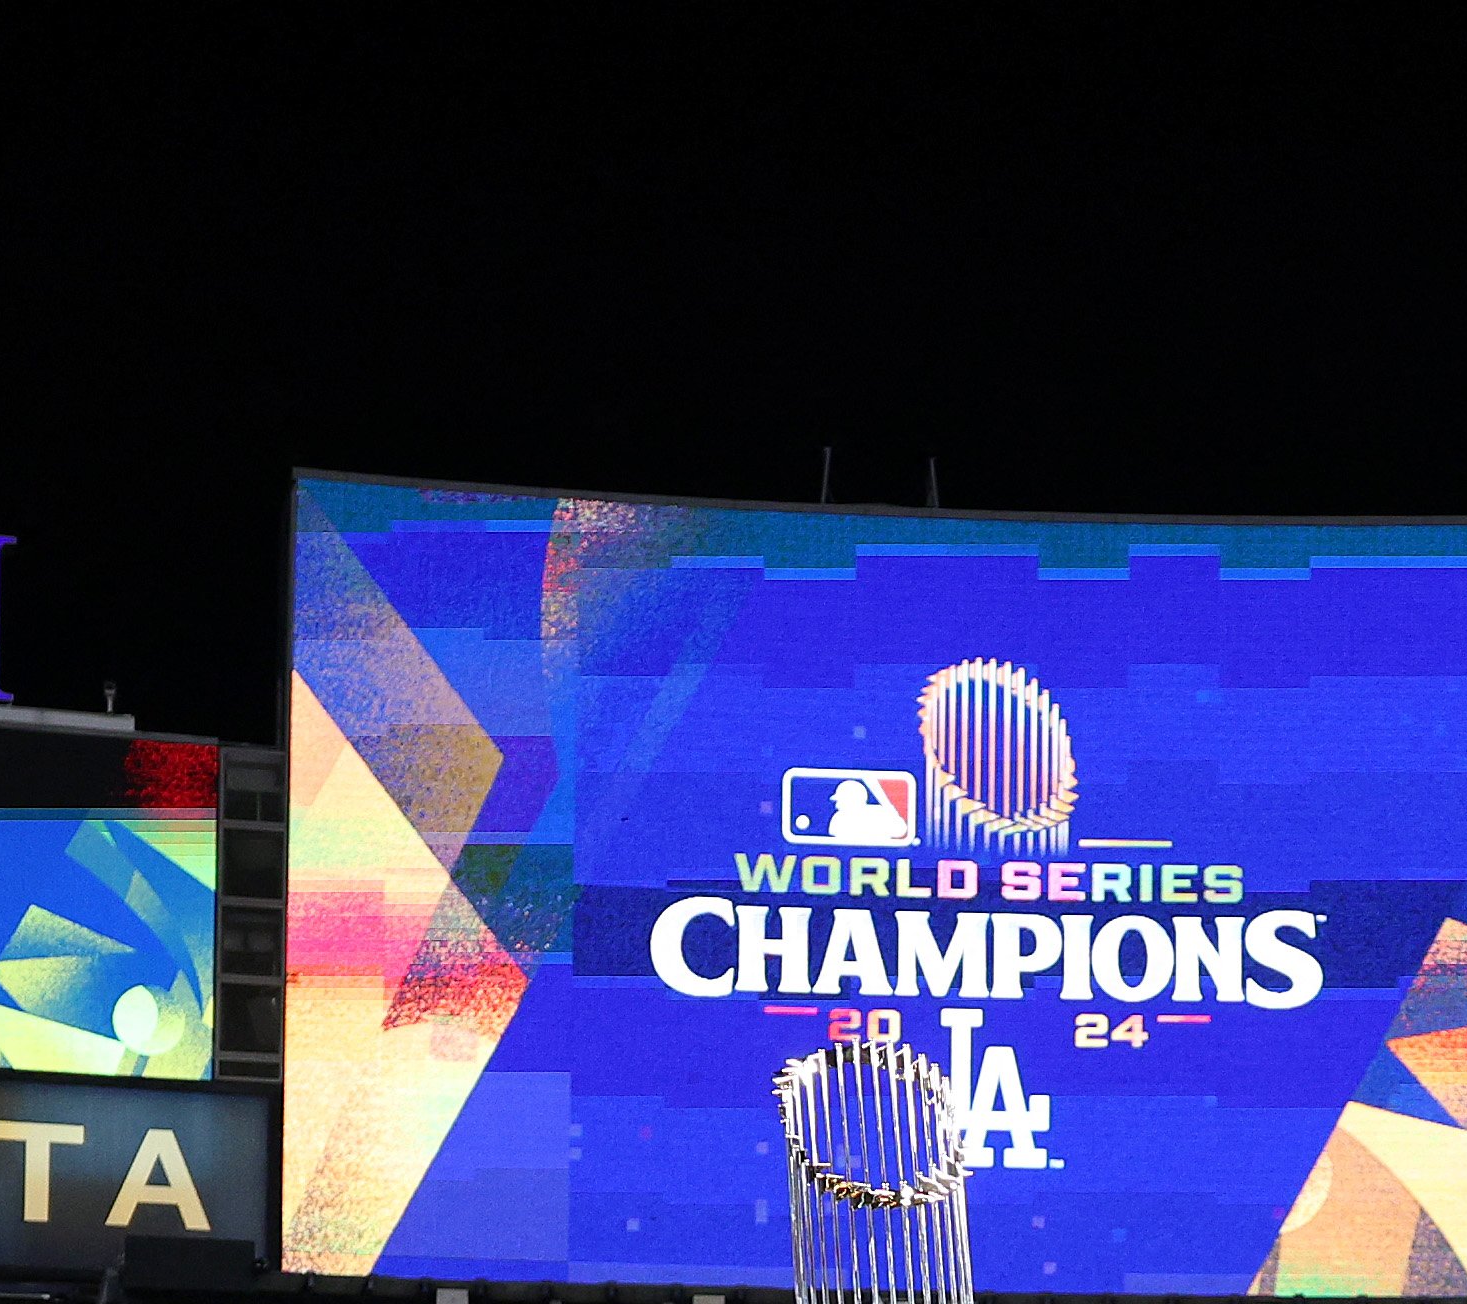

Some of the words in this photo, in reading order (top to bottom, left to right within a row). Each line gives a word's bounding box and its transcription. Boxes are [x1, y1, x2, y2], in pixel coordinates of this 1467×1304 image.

[733, 852, 979, 899] WORLD
[1000, 860, 1244, 904] SERIES
[649, 895, 1324, 1009] CHAMPIONS
[829, 1009, 902, 1048] 20
[1073, 1012, 1147, 1050] 24
